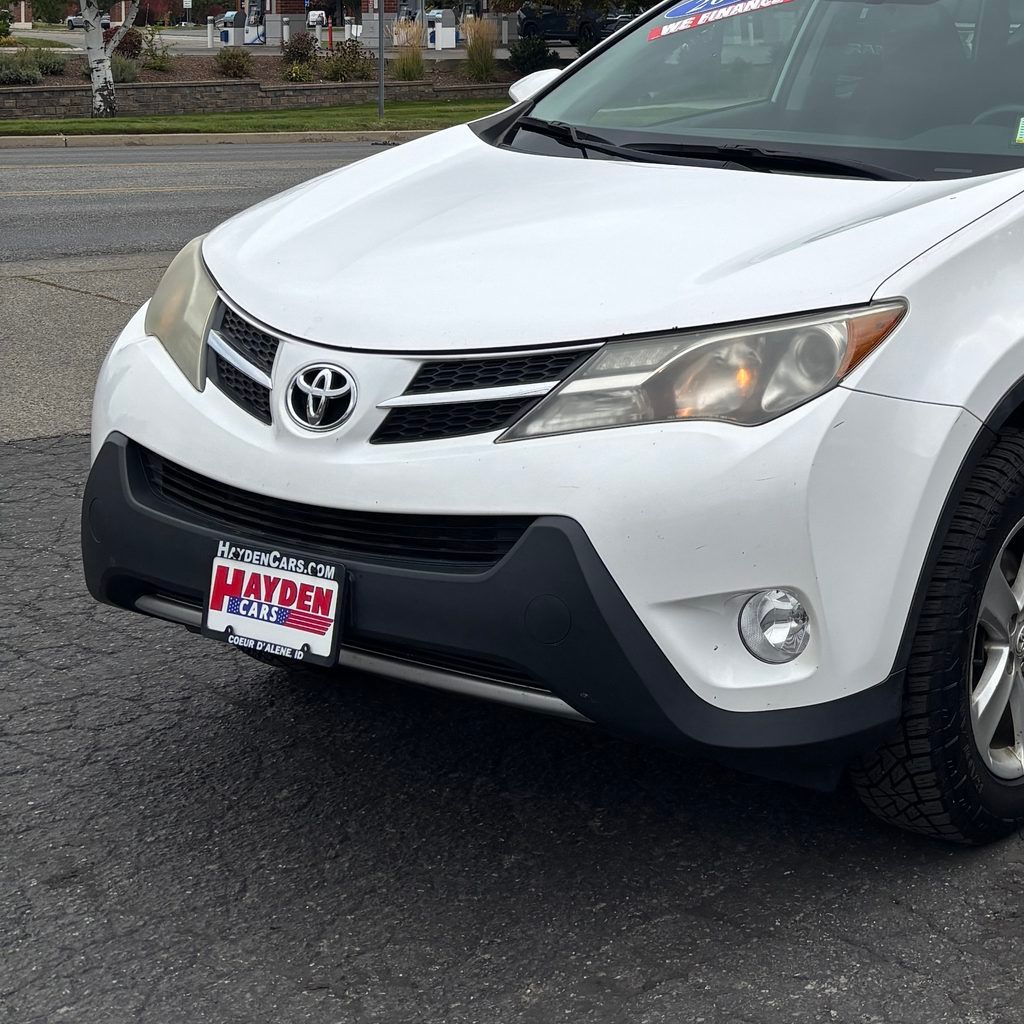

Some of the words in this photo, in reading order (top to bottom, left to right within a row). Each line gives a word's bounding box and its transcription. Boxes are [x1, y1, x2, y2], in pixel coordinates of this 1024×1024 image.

[660, 16, 695, 36] WE
[210, 564, 334, 616] HAYDEN
[240, 599, 279, 623] CARS
[228, 635, 254, 649] COEUR
[294, 650, 304, 660] ID
